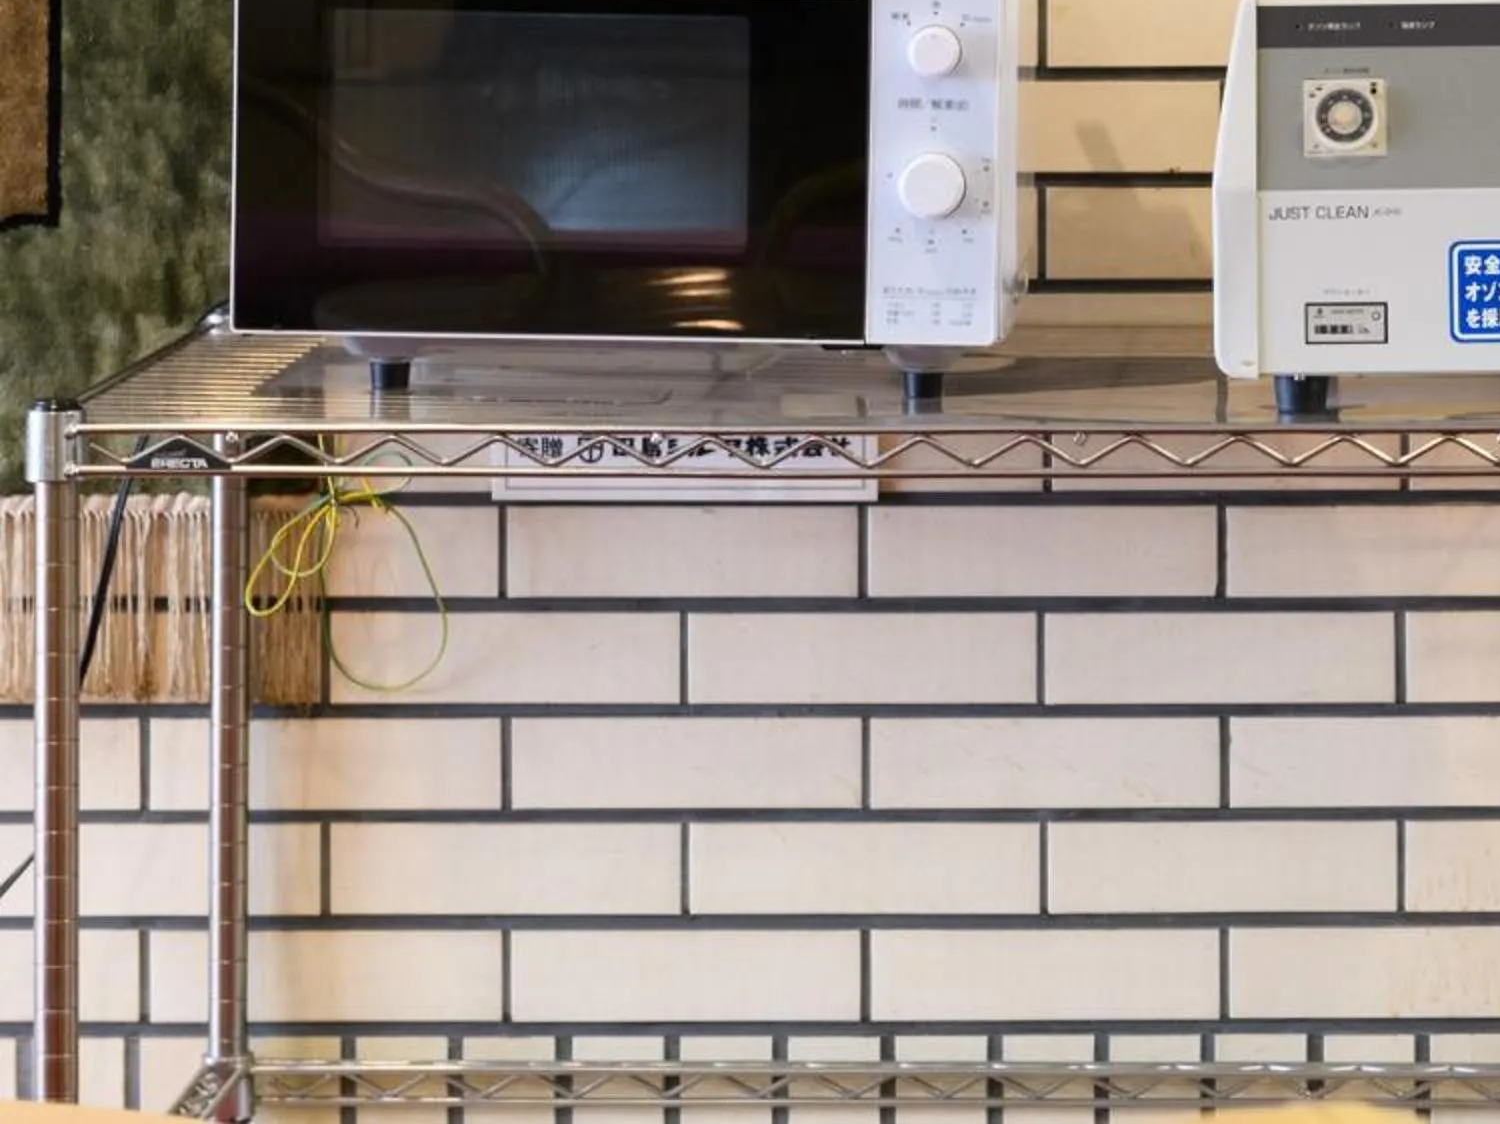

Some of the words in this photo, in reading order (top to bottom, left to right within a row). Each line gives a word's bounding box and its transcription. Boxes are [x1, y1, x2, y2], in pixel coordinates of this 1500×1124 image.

[1269, 205, 1311, 221] JUST
[1315, 204, 1370, 220] CLEAN
[151, 457, 209, 469] ERECTA
